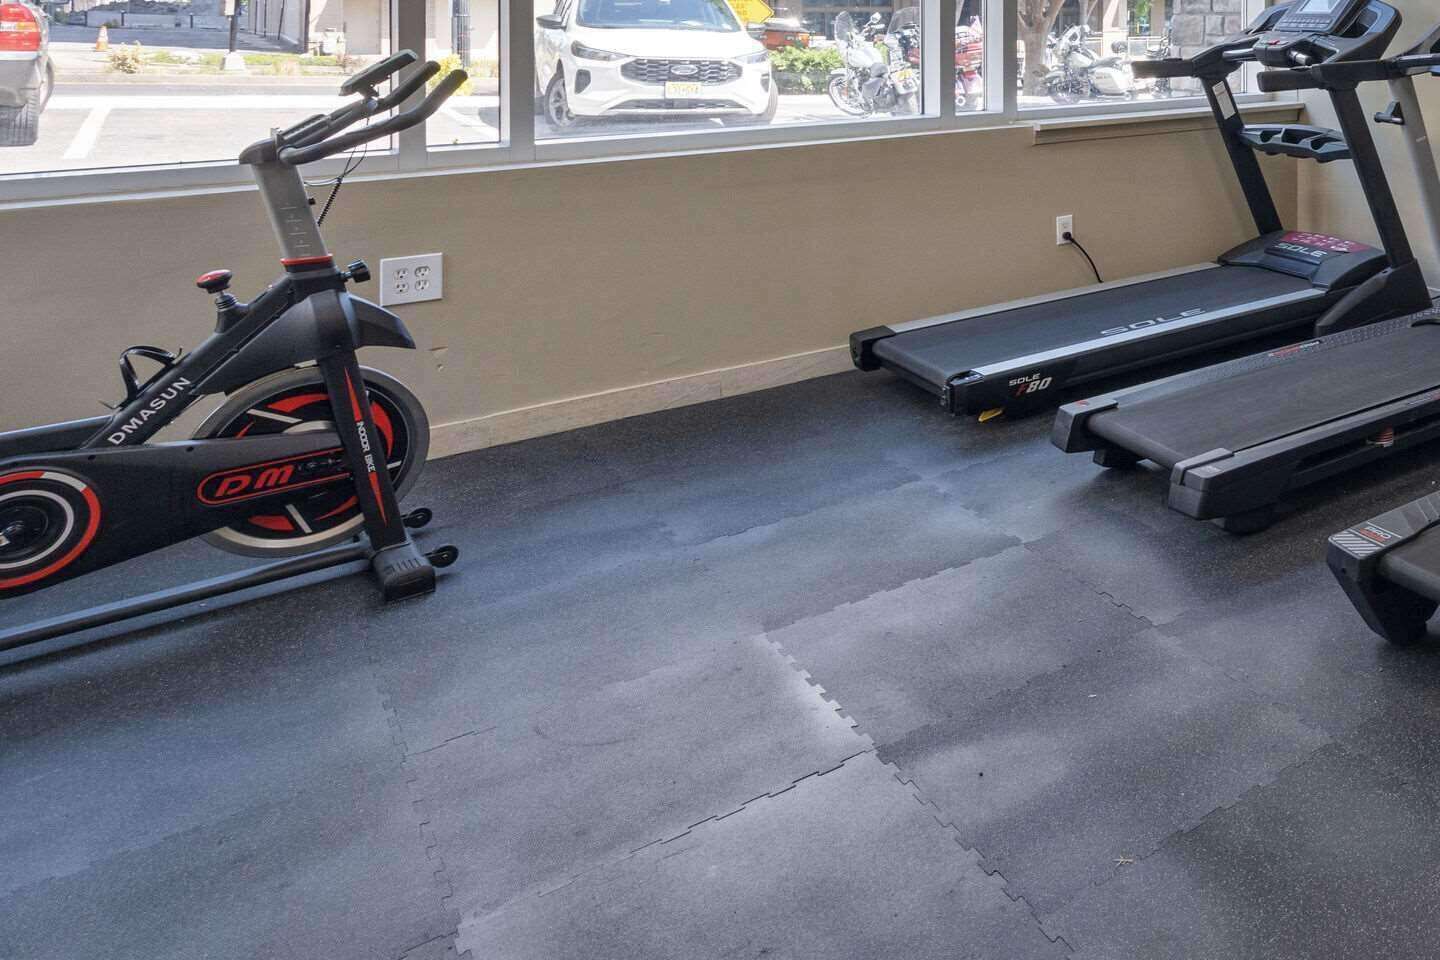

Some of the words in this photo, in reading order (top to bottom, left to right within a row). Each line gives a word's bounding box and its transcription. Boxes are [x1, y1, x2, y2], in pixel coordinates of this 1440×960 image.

[1273, 242, 1328, 258] SOLE
[1100, 307, 1206, 336] SOLE
[1009, 373, 1040, 386] SOLE
[1015, 376, 1053, 397] F80
[107, 376, 191, 445] DMASUN
[364, 453, 376, 473] BIKE
[1364, 526, 1392, 540] PRO
